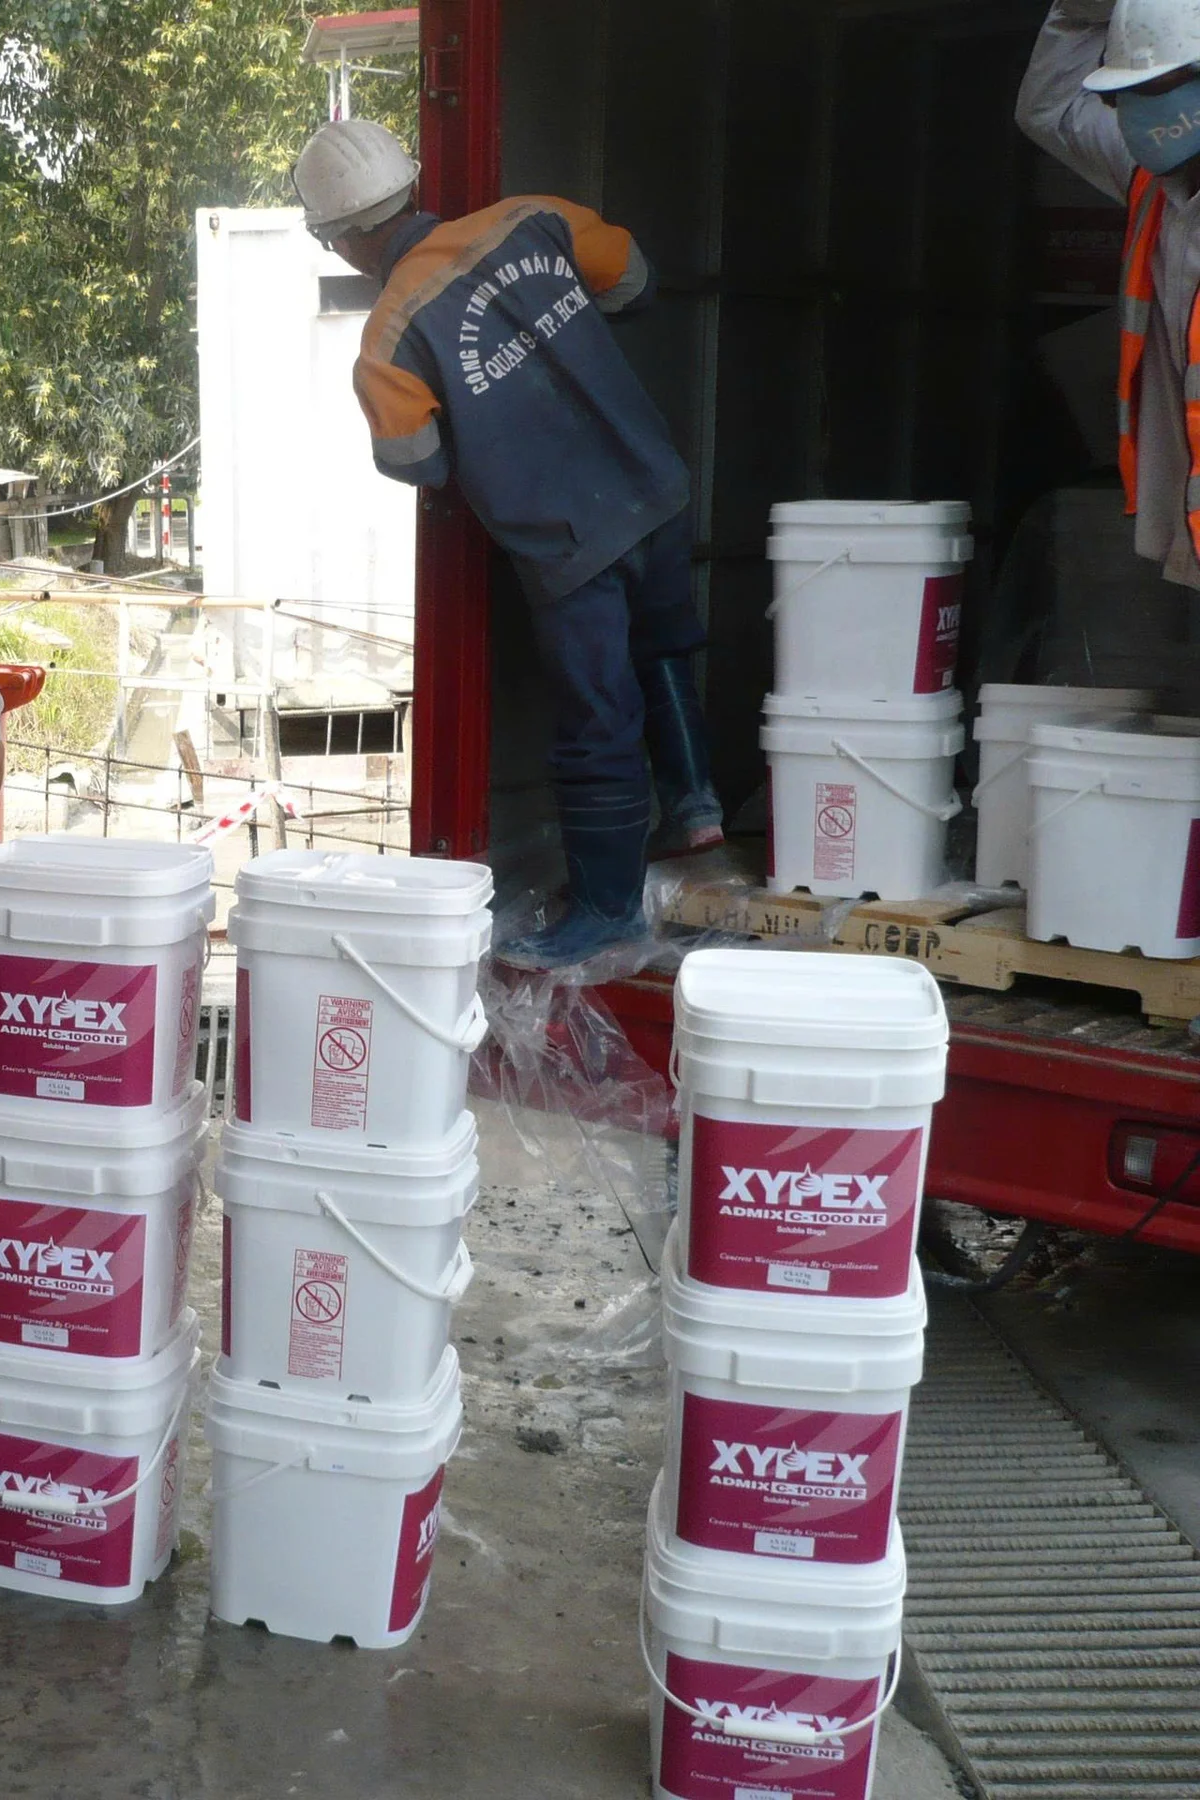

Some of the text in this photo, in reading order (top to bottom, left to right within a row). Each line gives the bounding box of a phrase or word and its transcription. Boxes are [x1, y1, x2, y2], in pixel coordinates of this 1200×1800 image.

[459, 320, 480, 342] TY
[864, 922, 942, 960] CORP.
[0, 990, 127, 1031] XYPEX
[330, 998, 371, 1010] WARNING
[0, 1025, 125, 1044] ADMIX C-1000 NF
[718, 1162, 888, 1209] XYPEX
[719, 1205, 884, 1225] ADMIX C-1000 NF
[806, 1227, 826, 1237] Bags
[306, 1253, 346, 1265] WARNING
[38, 1280, 87, 1292] C-1000
[90, 1285, 111, 1294] NF
[709, 1440, 869, 1485] XYPEX
[709, 1475, 865, 1499] ADMIX C-1000 NF
[85, 1519, 106, 1529] NF
[691, 1731, 842, 1759] ADMIX C-1000 NF
